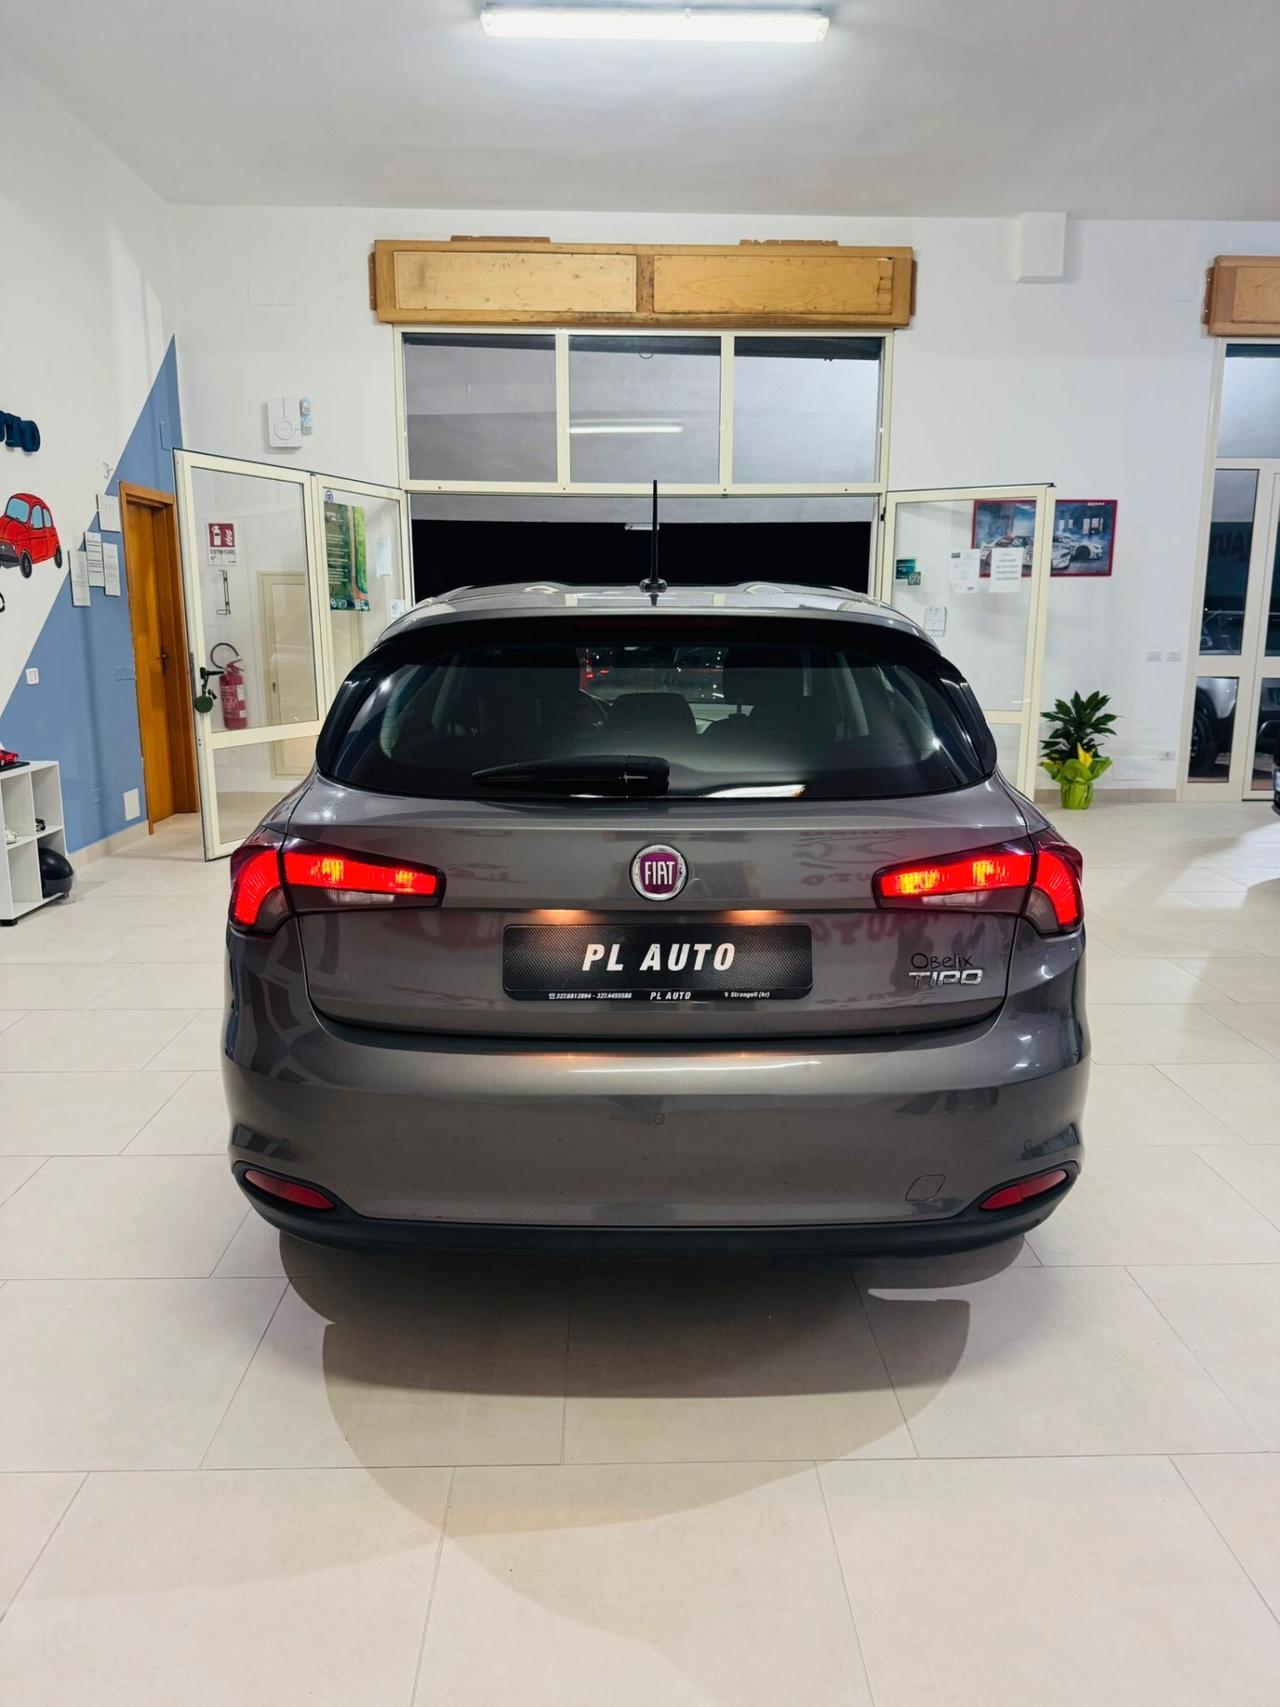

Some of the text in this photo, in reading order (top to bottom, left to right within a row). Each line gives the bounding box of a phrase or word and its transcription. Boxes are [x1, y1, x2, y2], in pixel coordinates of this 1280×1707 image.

[644, 861, 675, 885] FIAT
[581, 943, 735, 971] PL AUTO
[909, 969, 983, 987] TIPO
[650, 992, 692, 1000] PL AUTO
